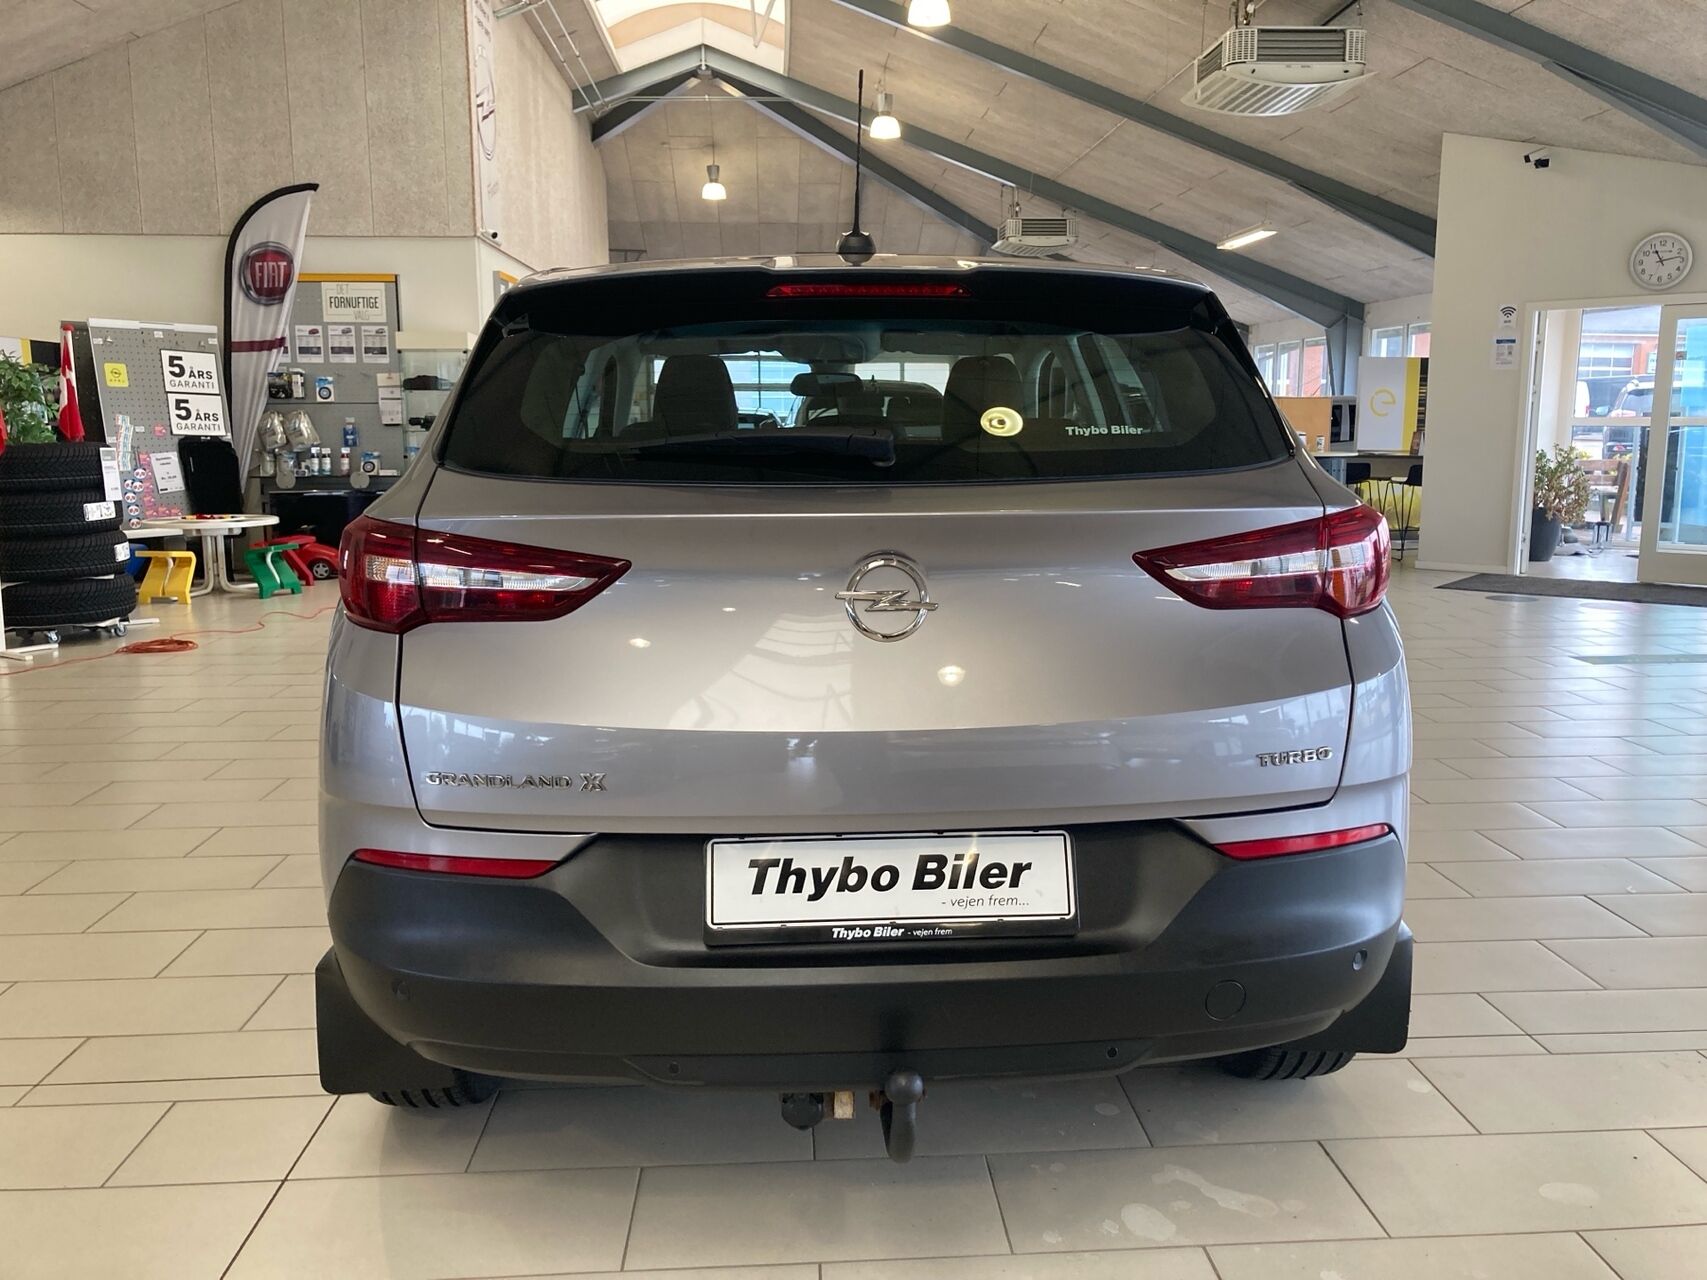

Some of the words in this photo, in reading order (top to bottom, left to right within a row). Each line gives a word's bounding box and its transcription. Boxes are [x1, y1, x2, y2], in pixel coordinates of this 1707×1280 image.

[254, 261, 288, 289] FIAT
[329, 296, 379, 309] FORNUFTIGE
[168, 355, 186, 378] 5
[188, 366, 213, 380] ÅRS
[169, 379, 215, 389] GARANTI
[175, 398, 192, 421] 5
[194, 408, 219, 422] ÅRS
[176, 422, 221, 432] GARANTI
[1065, 426, 1108, 437] Thybo
[1111, 425, 1143, 435] Biler
[1256, 745, 1333, 767] TURBO
[425, 772, 573, 788] GRANDLAND
[579, 772, 607, 792] X
[748, 857, 900, 901] Thybo
[912, 853, 1032, 891] Biler
[950, 896, 986, 908] vejen
[987, 894, 1030, 907] frem...
[831, 927, 871, 940] Thybo
[873, 926, 904, 938] Biler
[912, 928, 932, 937] vejen
[934, 927, 953, 936] frem
